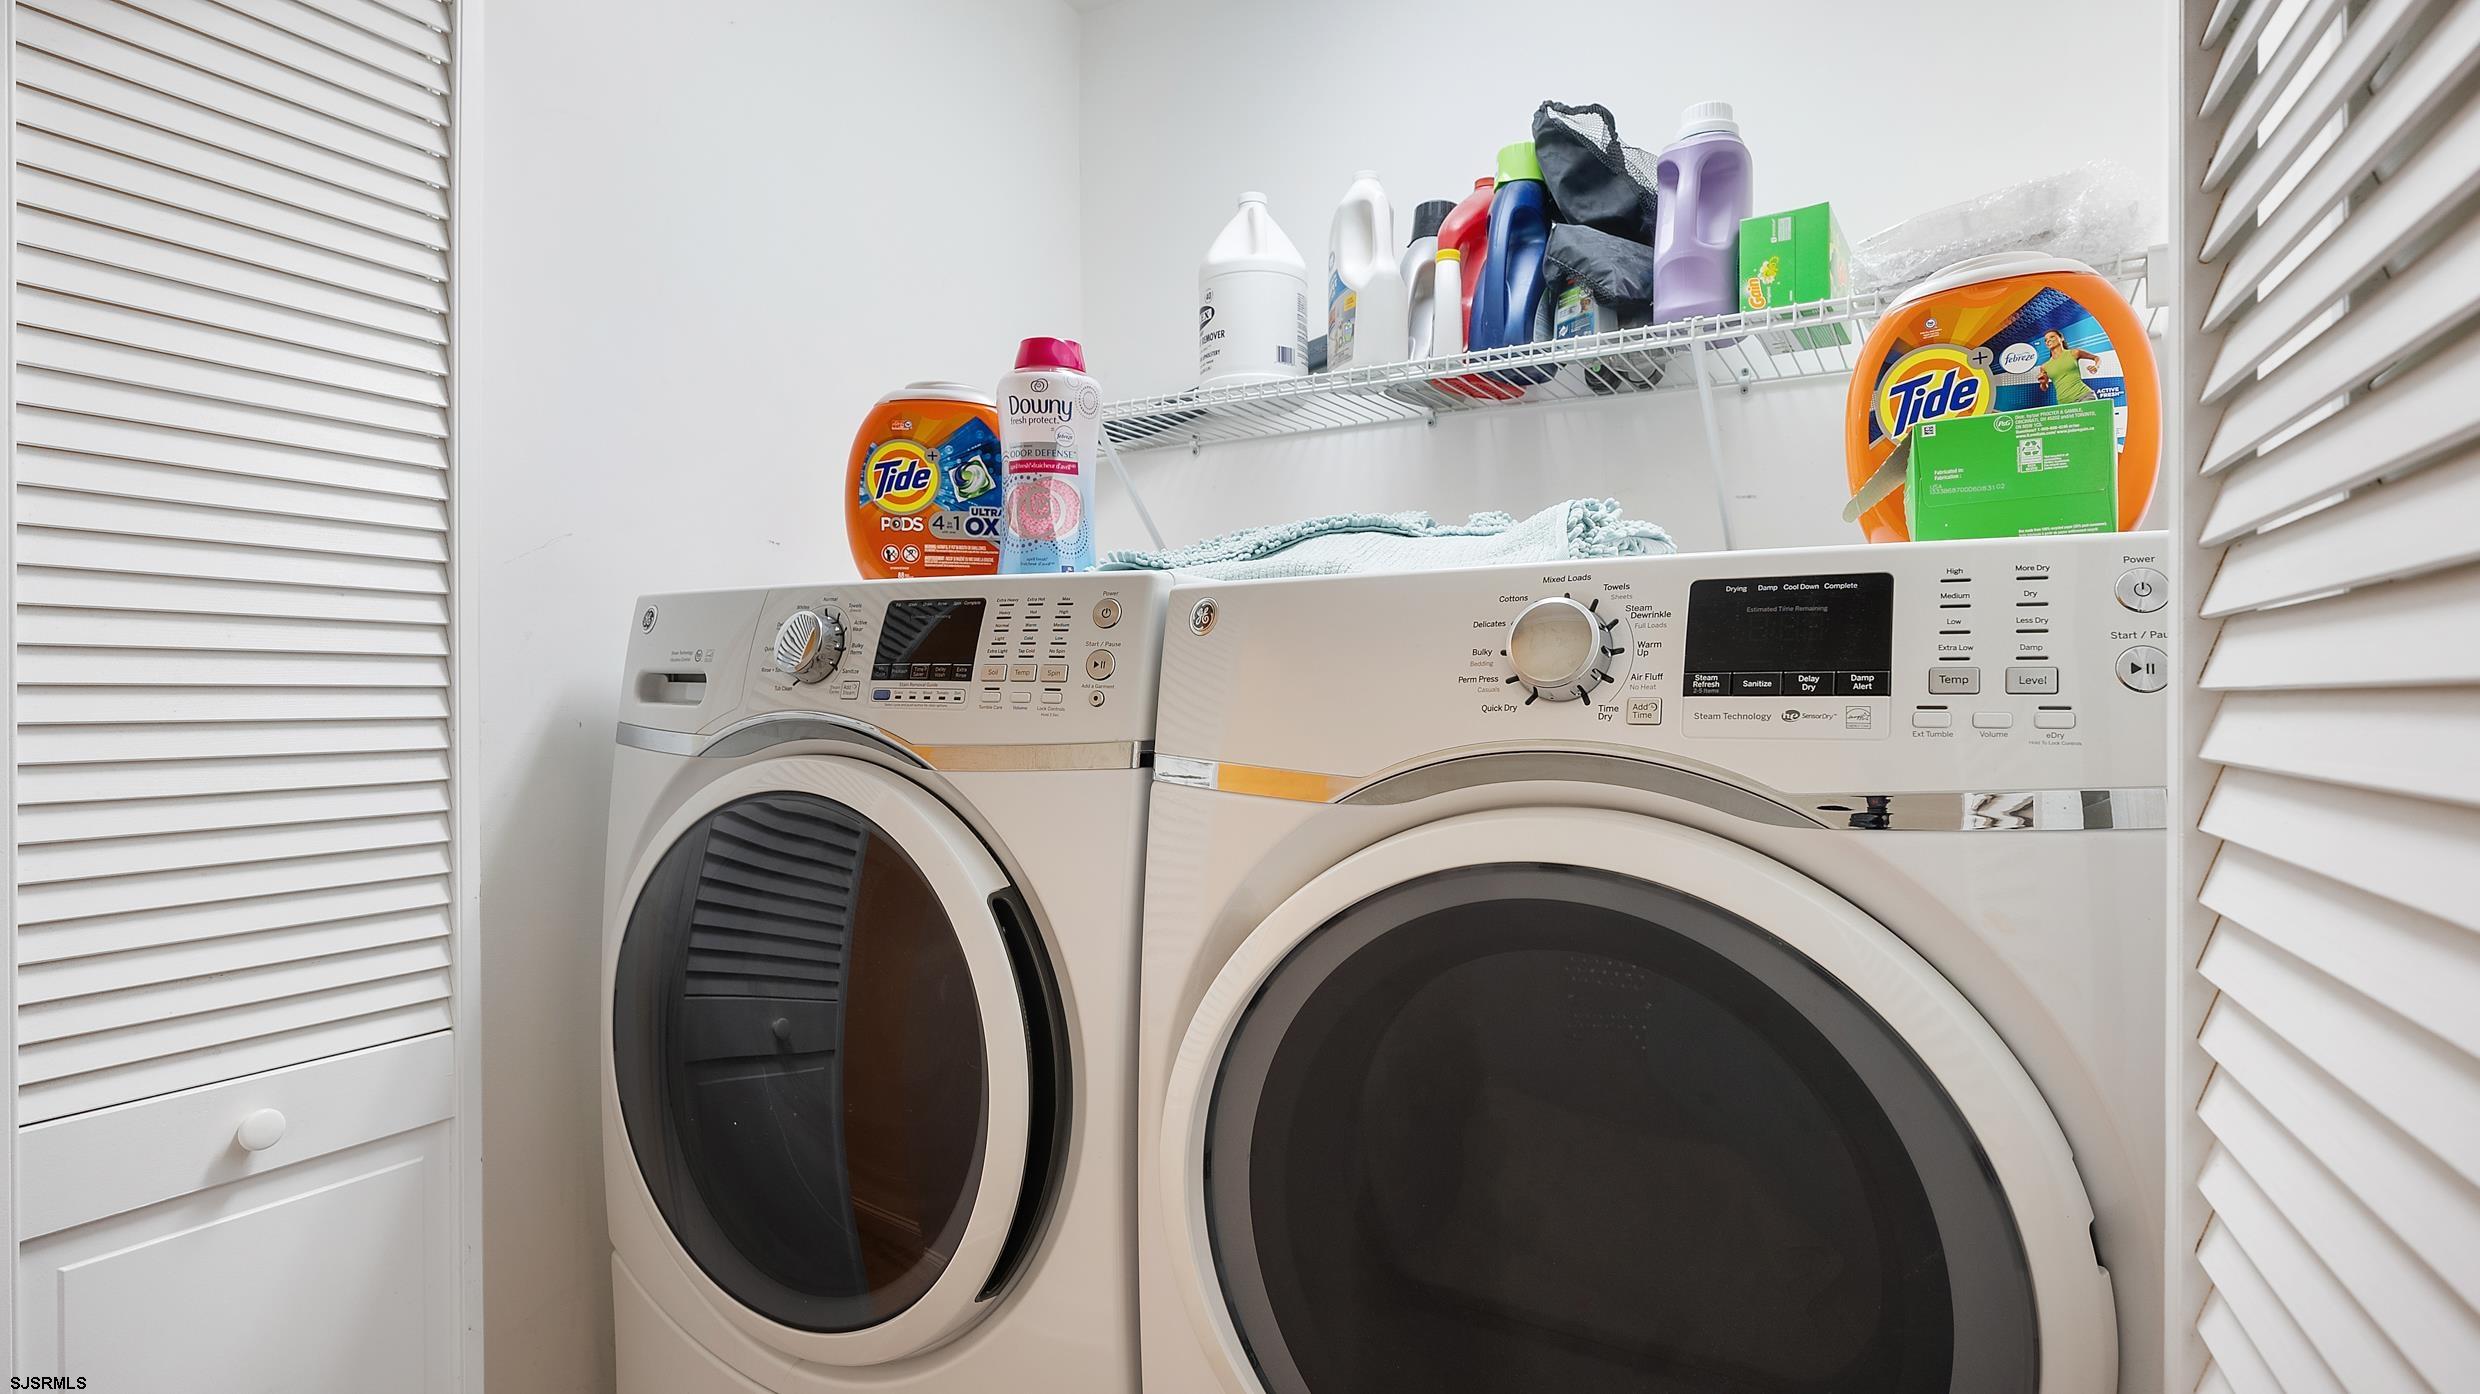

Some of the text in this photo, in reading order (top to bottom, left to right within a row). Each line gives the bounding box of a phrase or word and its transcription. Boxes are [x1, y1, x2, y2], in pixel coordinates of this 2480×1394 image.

[1748, 278, 1766, 309] Gain
[2004, 352, 2035, 365] febreze
[1889, 367, 1980, 439] Tide
[1009, 395, 1072, 422] Downy
[1010, 449, 1072, 458] ODOR DEFENSE
[874, 457, 931, 502] Tide
[881, 517, 924, 532] PODS
[932, 516, 944, 530] 4
[954, 516, 960, 530] 1
[1543, 574, 1592, 584] Mixed Loads
[2024, 590, 2038, 598] Dry
[1499, 595, 1528, 603] Cottons
[1473, 620, 1506, 628] Delicates
[1637, 649, 1648, 657] Up
[1631, 673, 1643, 681] Air
[1798, 675, 1820, 683] Delay
[1850, 674, 1875, 682] Damp
[1939, 675, 1969, 685] Temp
[2019, 676, 2047, 685] Level
[1743, 680, 1772, 688] Sanitize
[1802, 684, 1816, 692] Dry
[1482, 704, 1518, 713] Quick Dry
[1598, 713, 1613, 721] Dry
[1723, 712, 1771, 721] Technology
[2046, 732, 2065, 740] eDry
